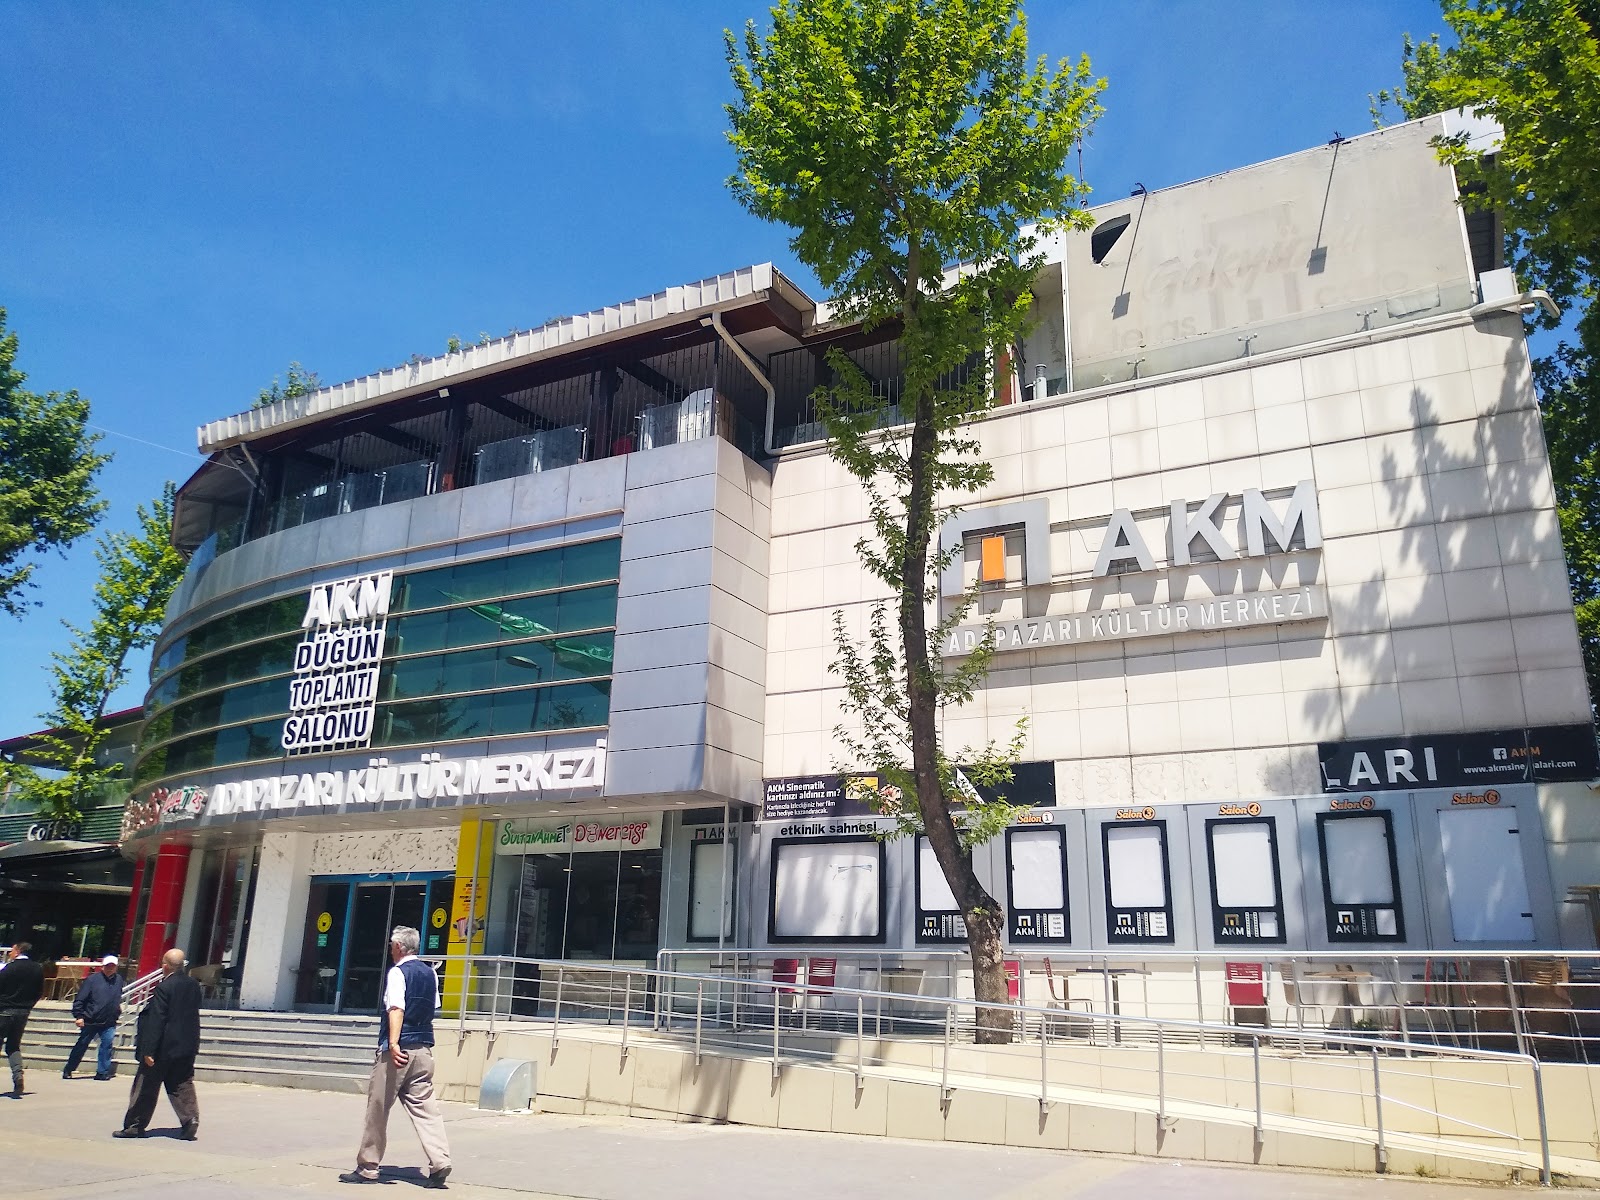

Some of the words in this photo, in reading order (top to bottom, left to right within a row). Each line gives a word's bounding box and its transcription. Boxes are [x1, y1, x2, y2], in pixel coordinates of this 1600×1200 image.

[1092, 480, 1322, 577] AKM
[302, 576, 392, 628] AKM
[1092, 605, 1189, 637] KÜLTÜR
[1201, 587, 1313, 627] MERKEZİ
[297, 629, 379, 670] DÜĞÜN
[292, 672, 373, 707] TOPLANTI
[285, 710, 369, 745] SALONU
[1511, 746, 1541, 758] AKM
[1464, 760, 1576, 774] www.akmsinealari.com
[206, 771, 344, 816] ADAPAZARI
[345, 753, 460, 803] KÜLTÜR
[463, 739, 606, 796] MERKEZİ
[767, 784, 785, 793] AKM
[786, 781, 825, 792] Sinematik
[767, 792, 797, 801] kartınızı
[799, 790, 825, 799] aldınız
[827, 789, 841, 798] mı?
[1452, 793, 1484, 805] Salon
[1219, 804, 1247, 816] Salon
[1330, 799, 1360, 810] Salon
[1017, 814, 1041, 824] Salon
[1116, 809, 1142, 820] Salon
[709, 826, 736, 838] AKM
[781, 823, 825, 835] etkinlik
[829, 821, 877, 833] sahnesi
[1015, 927, 1035, 935] AKM
[1114, 927, 1135, 935] AKM
[1221, 928, 1244, 936] AKM
[1336, 925, 1359, 933] AKM
